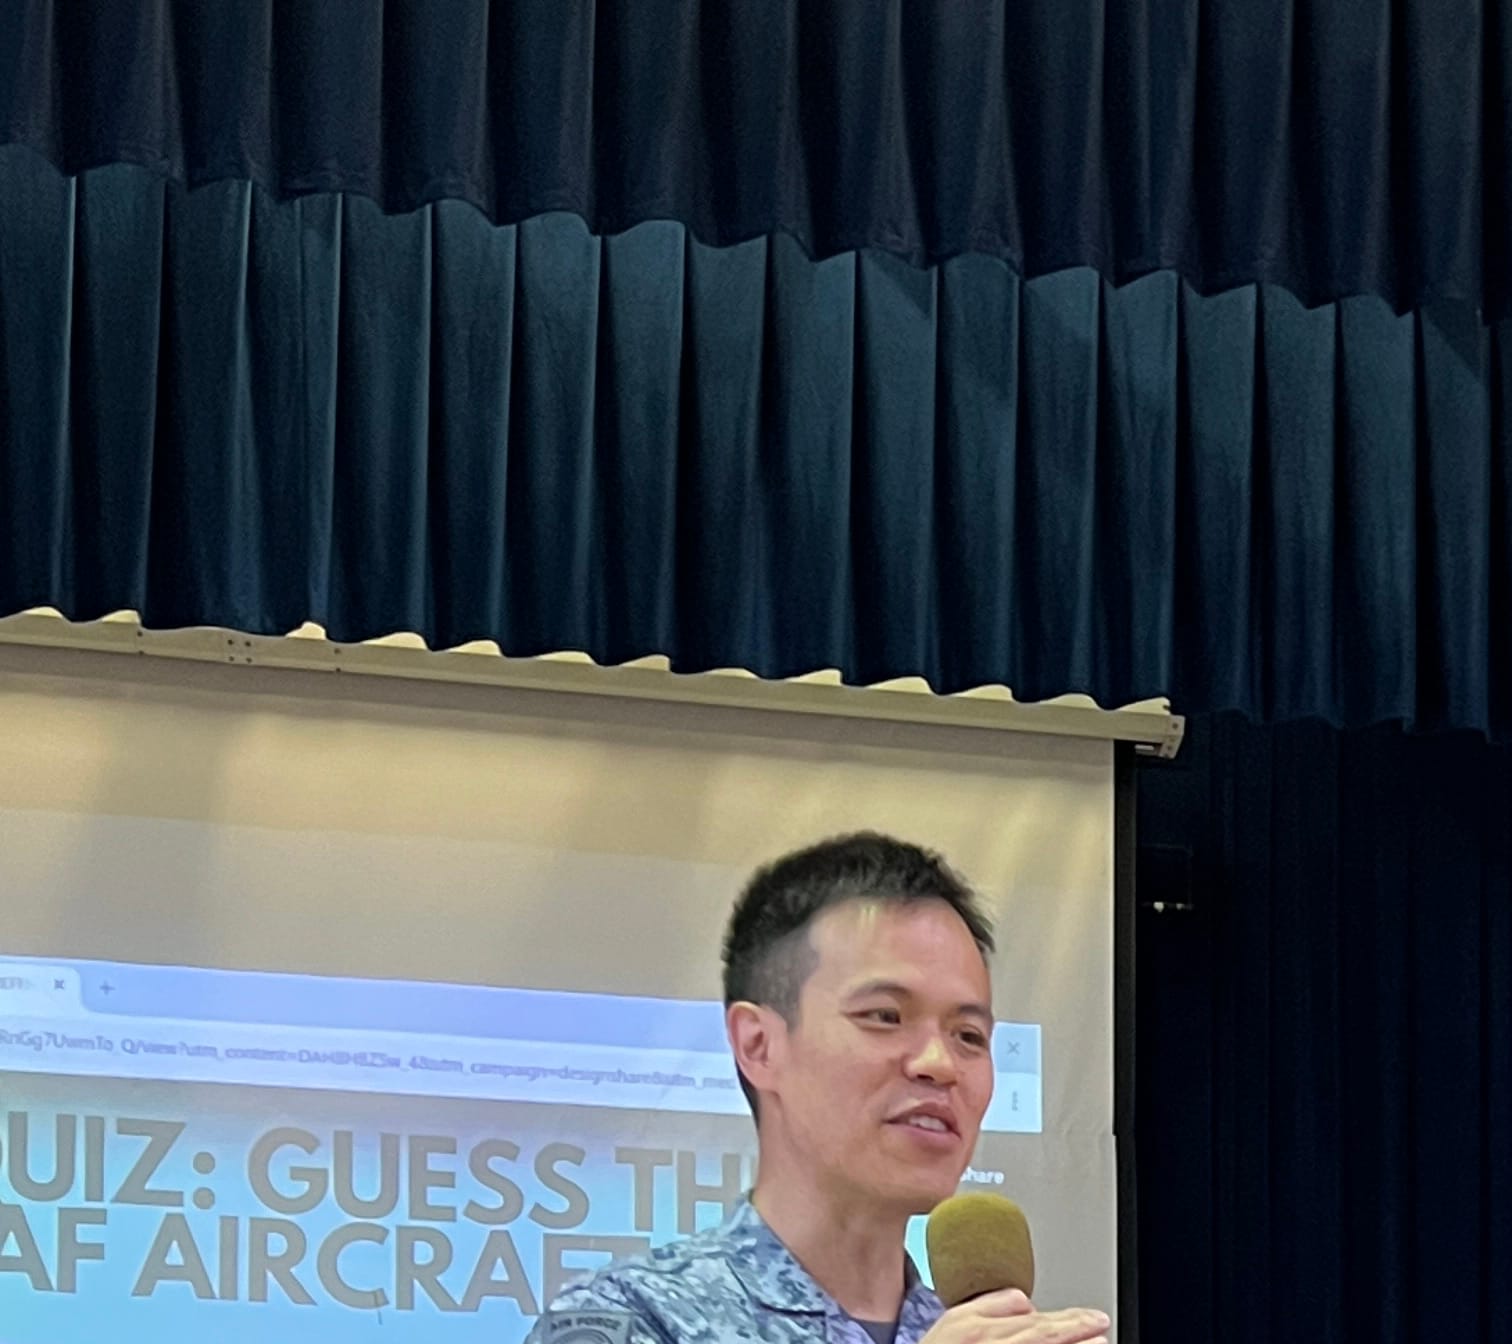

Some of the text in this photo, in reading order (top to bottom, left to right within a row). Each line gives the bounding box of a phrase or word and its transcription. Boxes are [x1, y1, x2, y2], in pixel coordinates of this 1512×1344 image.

[0, 1111, 757, 1235] UIZ: GUESS TH
